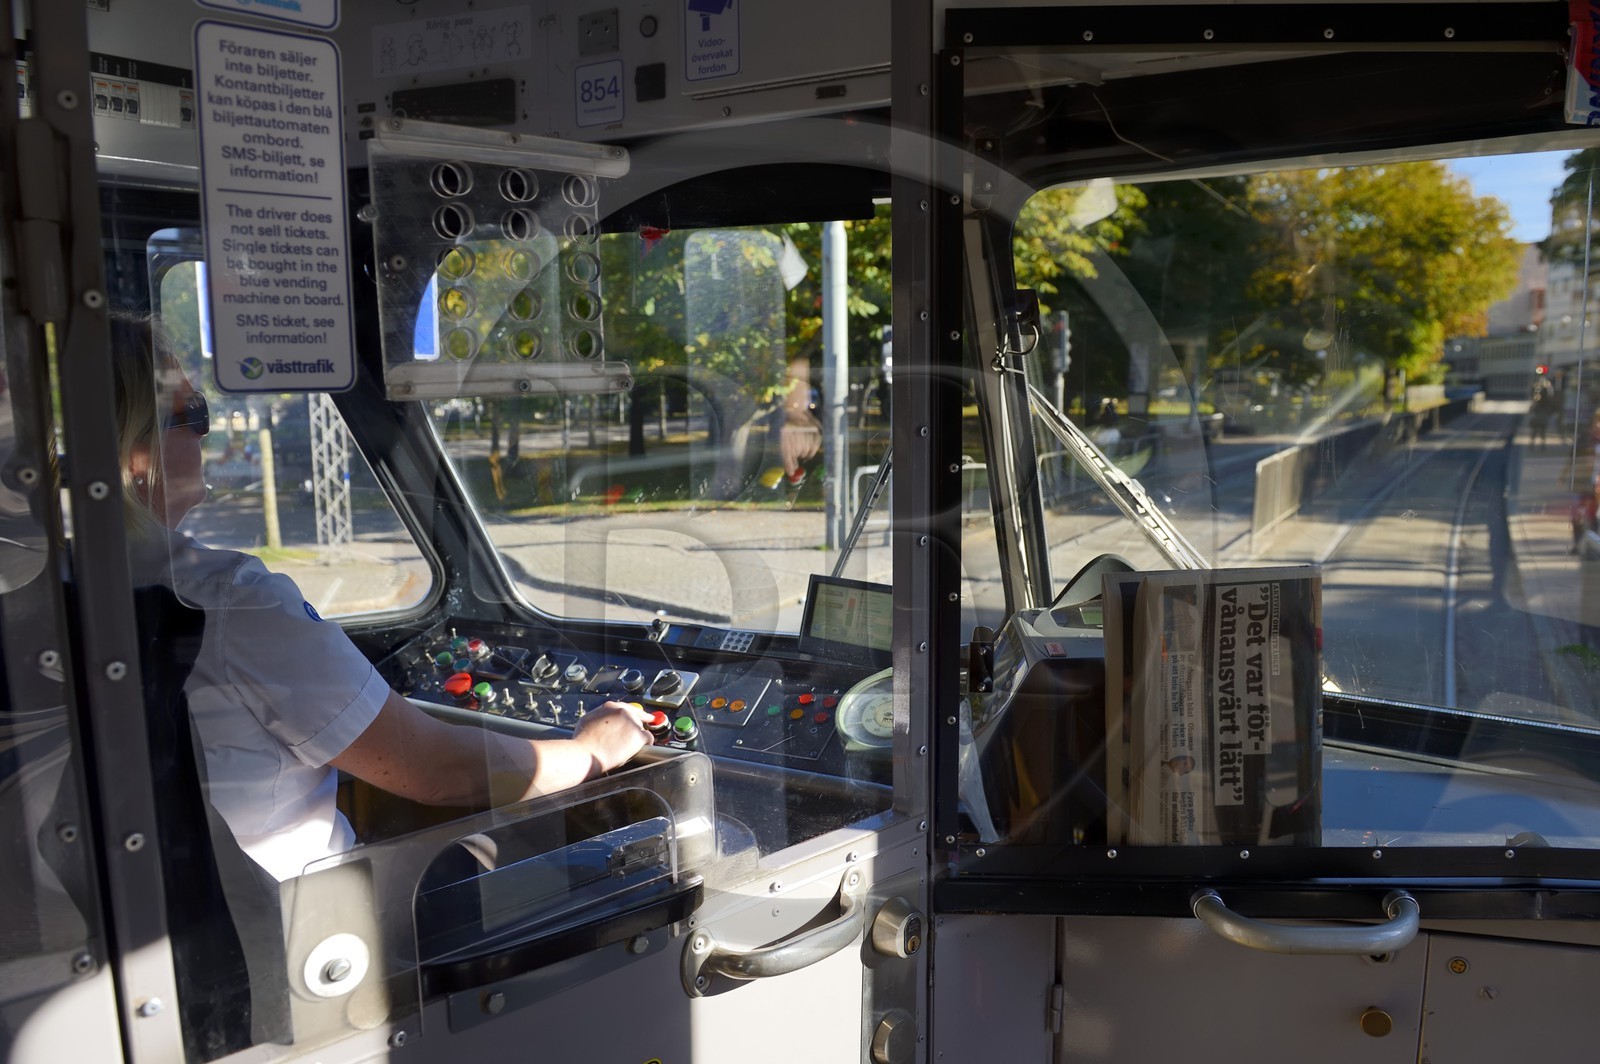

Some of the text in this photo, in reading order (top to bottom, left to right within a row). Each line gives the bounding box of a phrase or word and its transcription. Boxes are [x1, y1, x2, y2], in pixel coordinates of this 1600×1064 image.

[219, 39, 318, 66] Föraren säljer
[698, 39, 725, 48] Video-
[692, 49, 733, 62] övervakat
[225, 58, 314, 82] inte biljetter.
[698, 64, 726, 74] fordon
[214, 74, 324, 101] Kontantbiljetter
[580, 76, 620, 103] 854
[207, 92, 332, 118] kan köpas i den blå
[212, 110, 329, 135] biljettautomaten
[242, 132, 304, 148] ombord.
[221, 145, 325, 168] SMS-biljett, se
[230, 164, 318, 183] information!
[225, 204, 332, 223] The driver does
[231, 224, 330, 240] not sell tickets.
[222, 239, 338, 257] Single tickets can
[227, 256, 337, 273] be bought in the
[239, 276, 327, 291] blue vending
[223, 292, 344, 306] machine on board.
[236, 314, 335, 328] SMS ticket, see
[246, 332, 327, 344] information!
[267, 360, 335, 374] västtrafik
[1218, 587, 1244, 735] vånansvärt
[1246, 653, 1263, 696] var
[1172, 692, 1179, 700] ha
[1247, 704, 1270, 751] för-
[1172, 792, 1180, 843] för misshandel
[1187, 809, 1196, 831] pojkar
